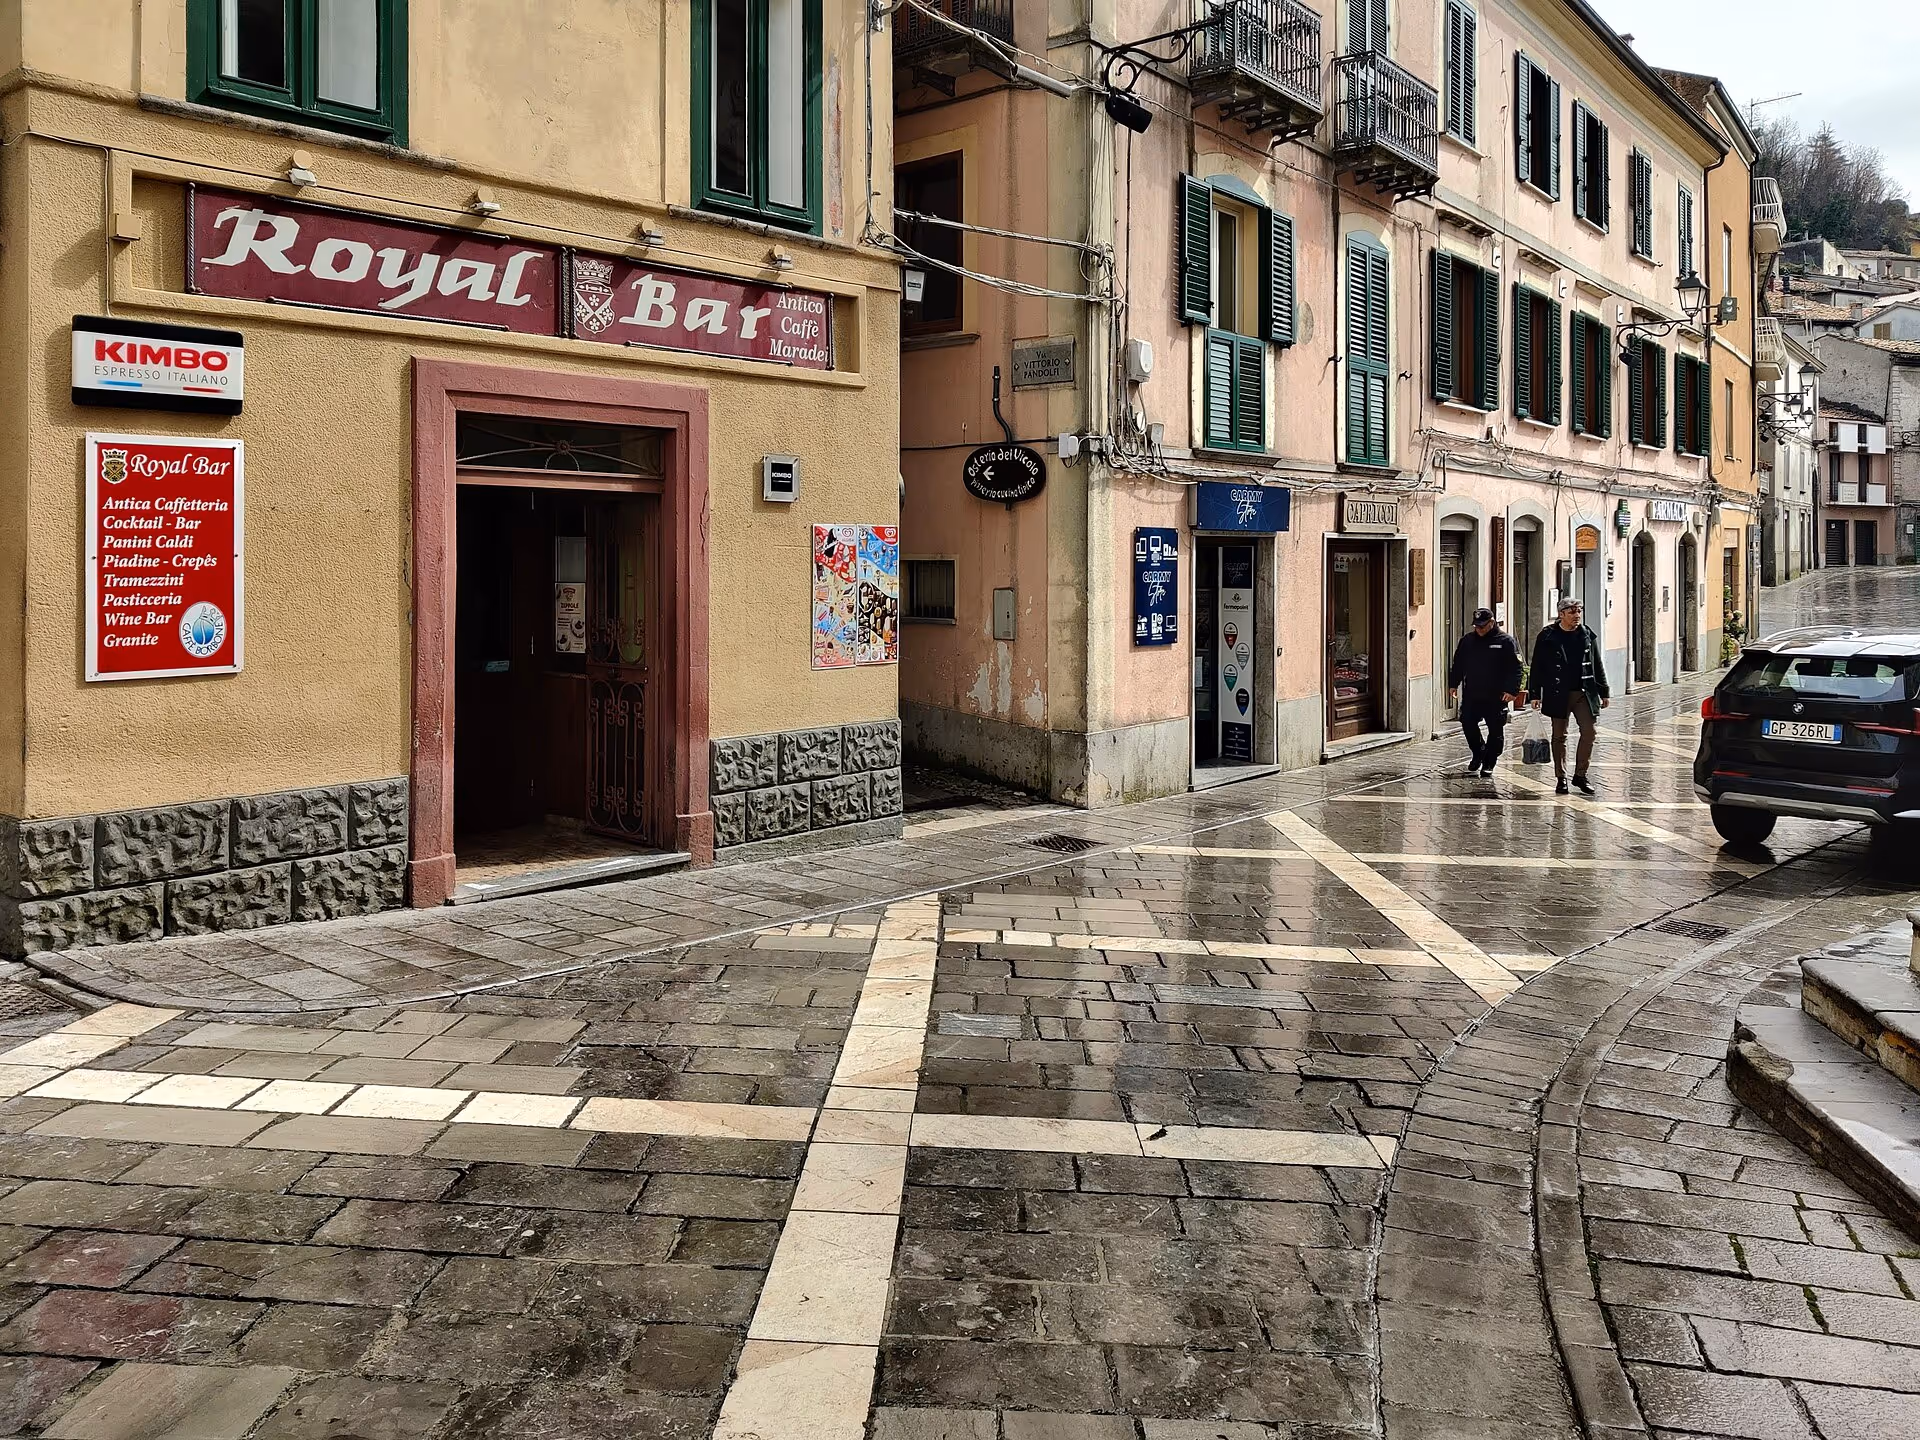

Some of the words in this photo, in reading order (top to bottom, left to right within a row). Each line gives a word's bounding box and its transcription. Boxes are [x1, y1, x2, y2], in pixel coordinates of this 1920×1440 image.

[200, 205, 544, 310] Royal
[619, 273, 772, 340] Bar
[776, 291, 824, 315] Antico
[780, 316, 819, 339] Caffè
[94, 339, 229, 372] KIMBO
[768, 338, 830, 363] Maradei
[1023, 358, 1061, 369] VITTORIO
[94, 365, 161, 380] ESPRESSO
[168, 371, 228, 386] ITALIANO
[1023, 367, 1060, 379] PANDOLFI
[130, 453, 193, 480] Royal
[192, 456, 231, 475] Bar
[968, 449, 997, 477] Osteria
[997, 448, 1013, 461] del
[1014, 448, 1039, 476] Vicolo
[1230, 489, 1263, 503] CARMY
[102, 496, 151, 511] Antica
[154, 497, 229, 515] Caffetteria
[1347, 502, 1397, 525] CAPRICCI
[102, 515, 163, 530] Cocktail
[174, 516, 201, 530] Bar
[102, 534, 152, 549] Panini
[155, 534, 194, 549] Caldi
[102, 553, 160, 568] Piadine
[172, 553, 217, 571] Crepês
[103, 573, 184, 588] Tramezzini
[1142, 571, 1172, 583] CARMY
[102, 592, 182, 607] Pasticceria
[104, 612, 142, 627] Wine
[145, 611, 172, 625] Bar
[103, 632, 159, 648] Granite
[195, 621, 224, 656] BORBONE
[1771, 721, 1787, 735] GP
[1791, 723, 1832, 739] 326RL
